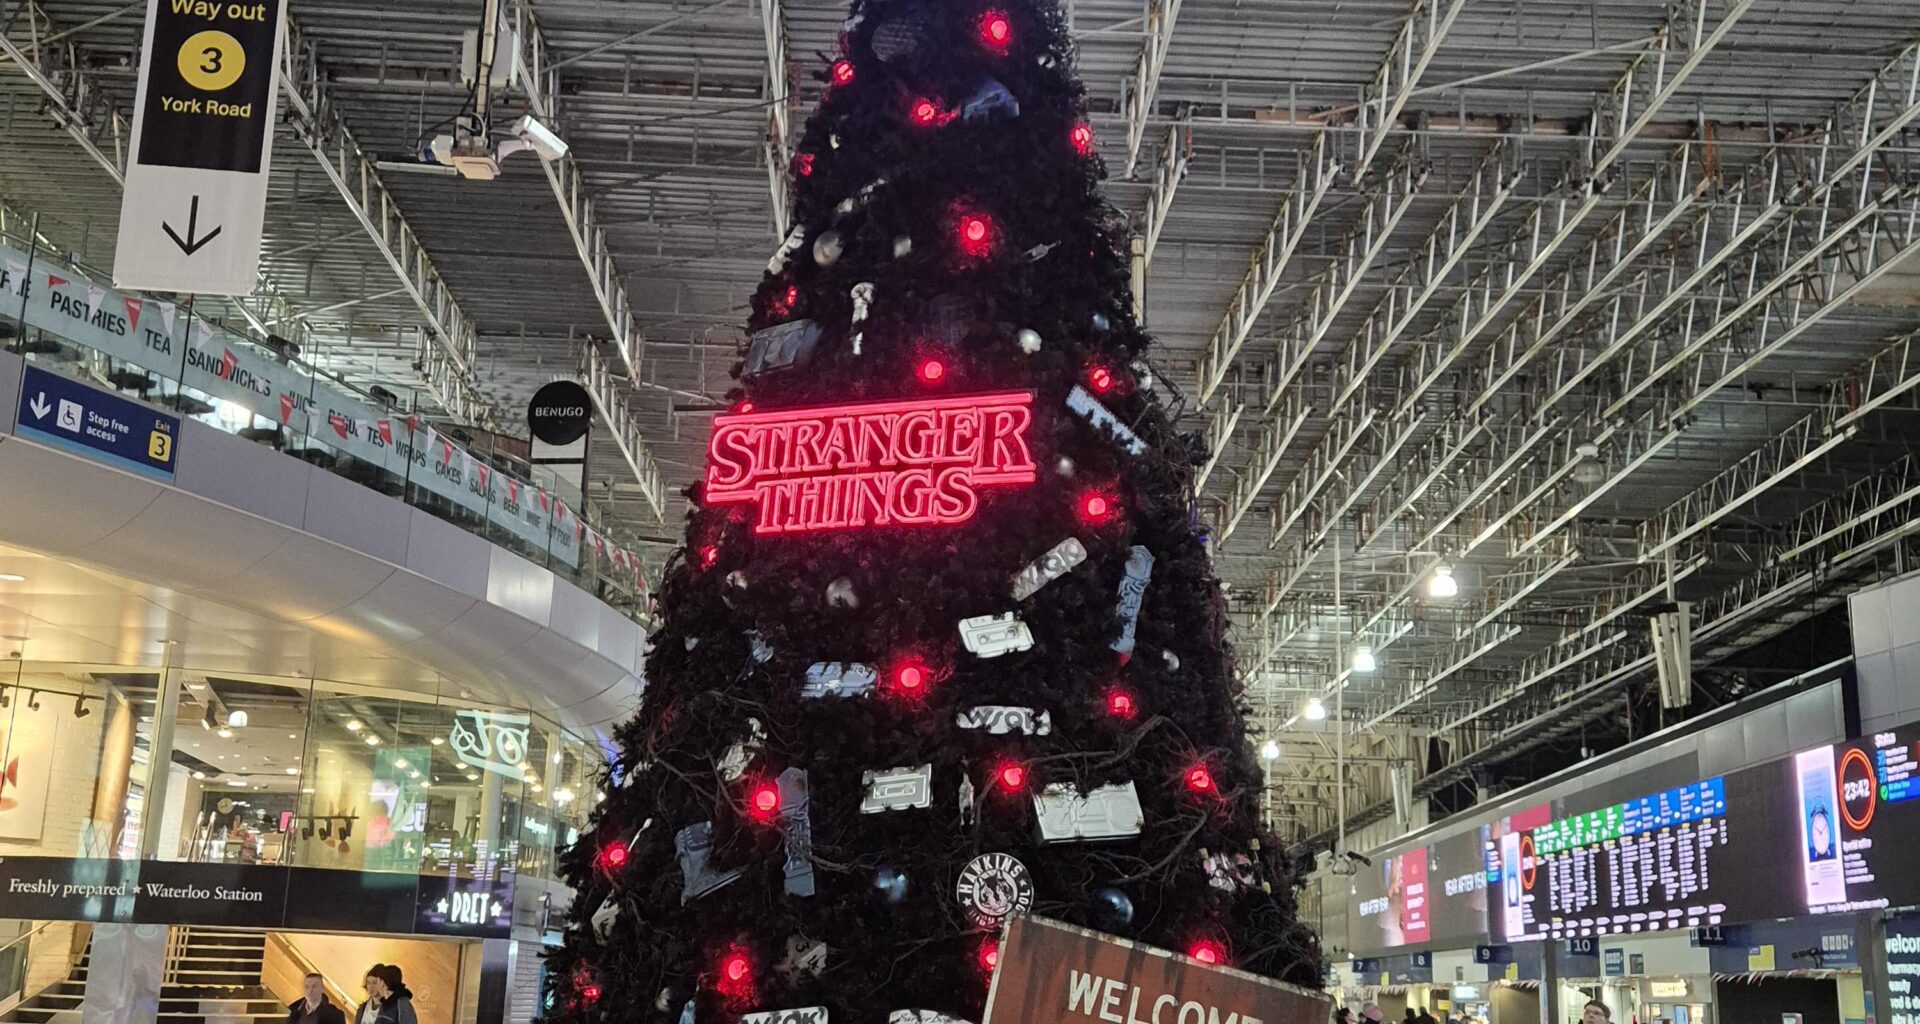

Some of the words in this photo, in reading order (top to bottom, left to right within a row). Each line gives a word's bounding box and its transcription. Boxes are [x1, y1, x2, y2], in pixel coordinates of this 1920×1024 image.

[171, 0, 221, 20] Way
[227, 1, 266, 21] out
[200, 46, 223, 74] 3
[161, 96, 201, 114] York
[206, 101, 252, 118] Road
[51, 290, 126, 336] PASTRIES
[145, 328, 171, 356] TEA
[88, 411, 110, 428] Step
[111, 417, 130, 434] free
[535, 406, 584, 417] BENUGO
[86, 425, 117, 443] access
[155, 419, 171, 433] Exit
[154, 436, 166, 457] 3
[707, 405, 1037, 491] STRANGER
[754, 467, 978, 533] THINGS
[1843, 778, 1871, 801] 23:42
[959, 855, 1023, 894] HAWKINS
[9, 878, 59, 897] Freshly
[63, 883, 126, 897] prepared
[146, 883, 210, 900] Waterloo
[214, 887, 263, 902] Station
[451, 891, 490, 925] PRET
[1703, 926, 1724, 941] 11
[1482, 949, 1490, 960] 9
[1573, 939, 1591, 952] 10
[1357, 961, 1364, 971] 7
[1417, 955, 1426, 965] 8
[1068, 970, 1264, 1024] WELCO
